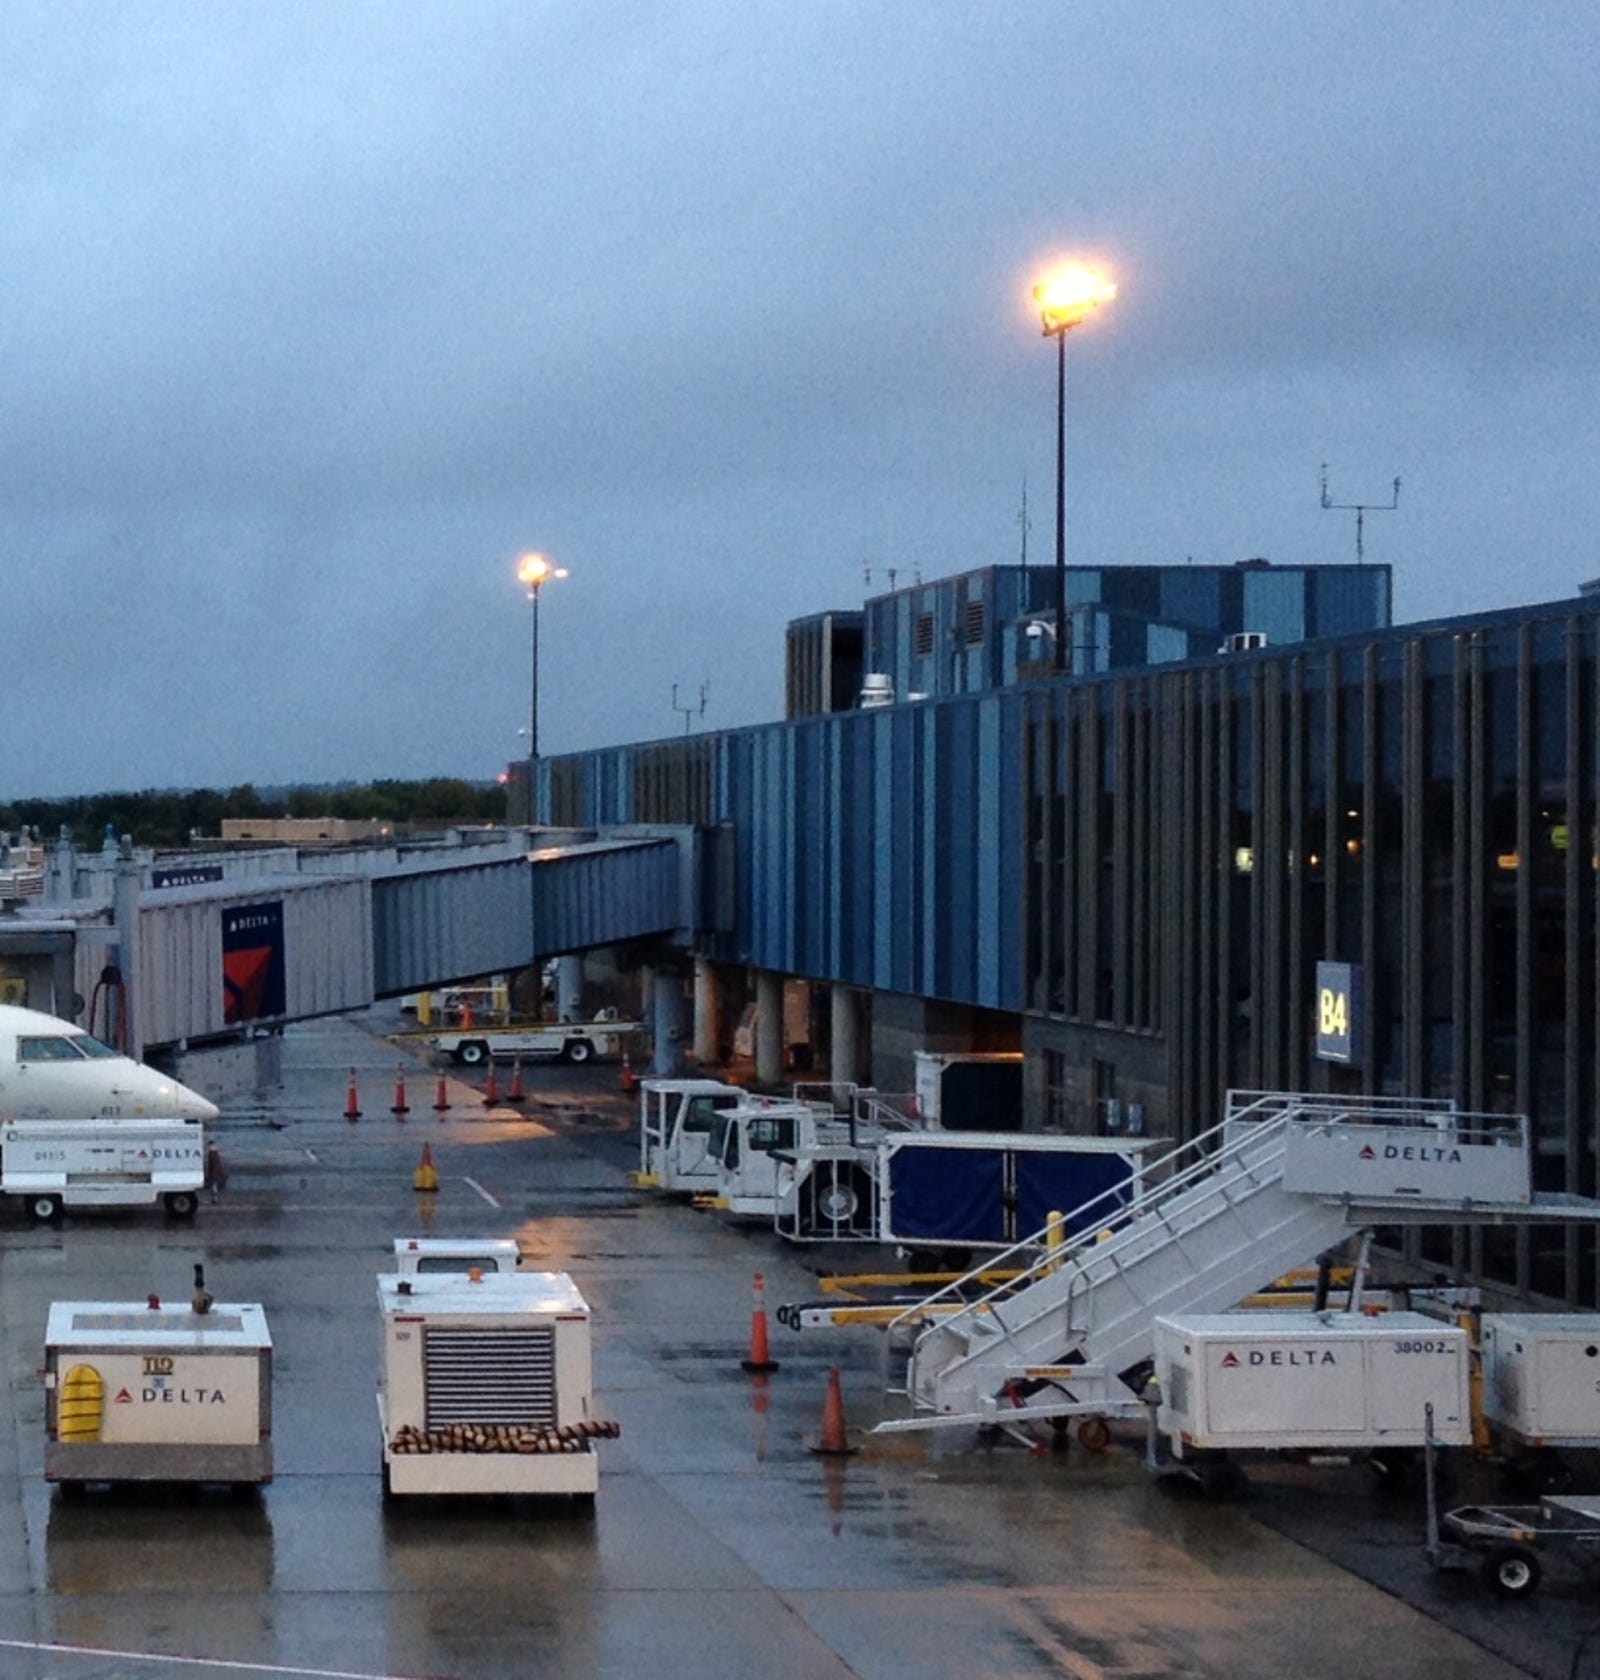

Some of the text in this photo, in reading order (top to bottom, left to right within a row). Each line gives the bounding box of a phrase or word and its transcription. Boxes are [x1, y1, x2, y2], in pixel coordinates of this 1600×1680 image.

[171, 875, 205, 885] DELTA
[239, 915, 268, 929] DELTA
[1320, 988, 1347, 1037] B4
[152, 1149, 201, 1159] DELTA
[1384, 1145, 1462, 1163] DELTA
[1249, 1350, 1336, 1366] DELTA
[142, 1387, 226, 1404] DELTA
